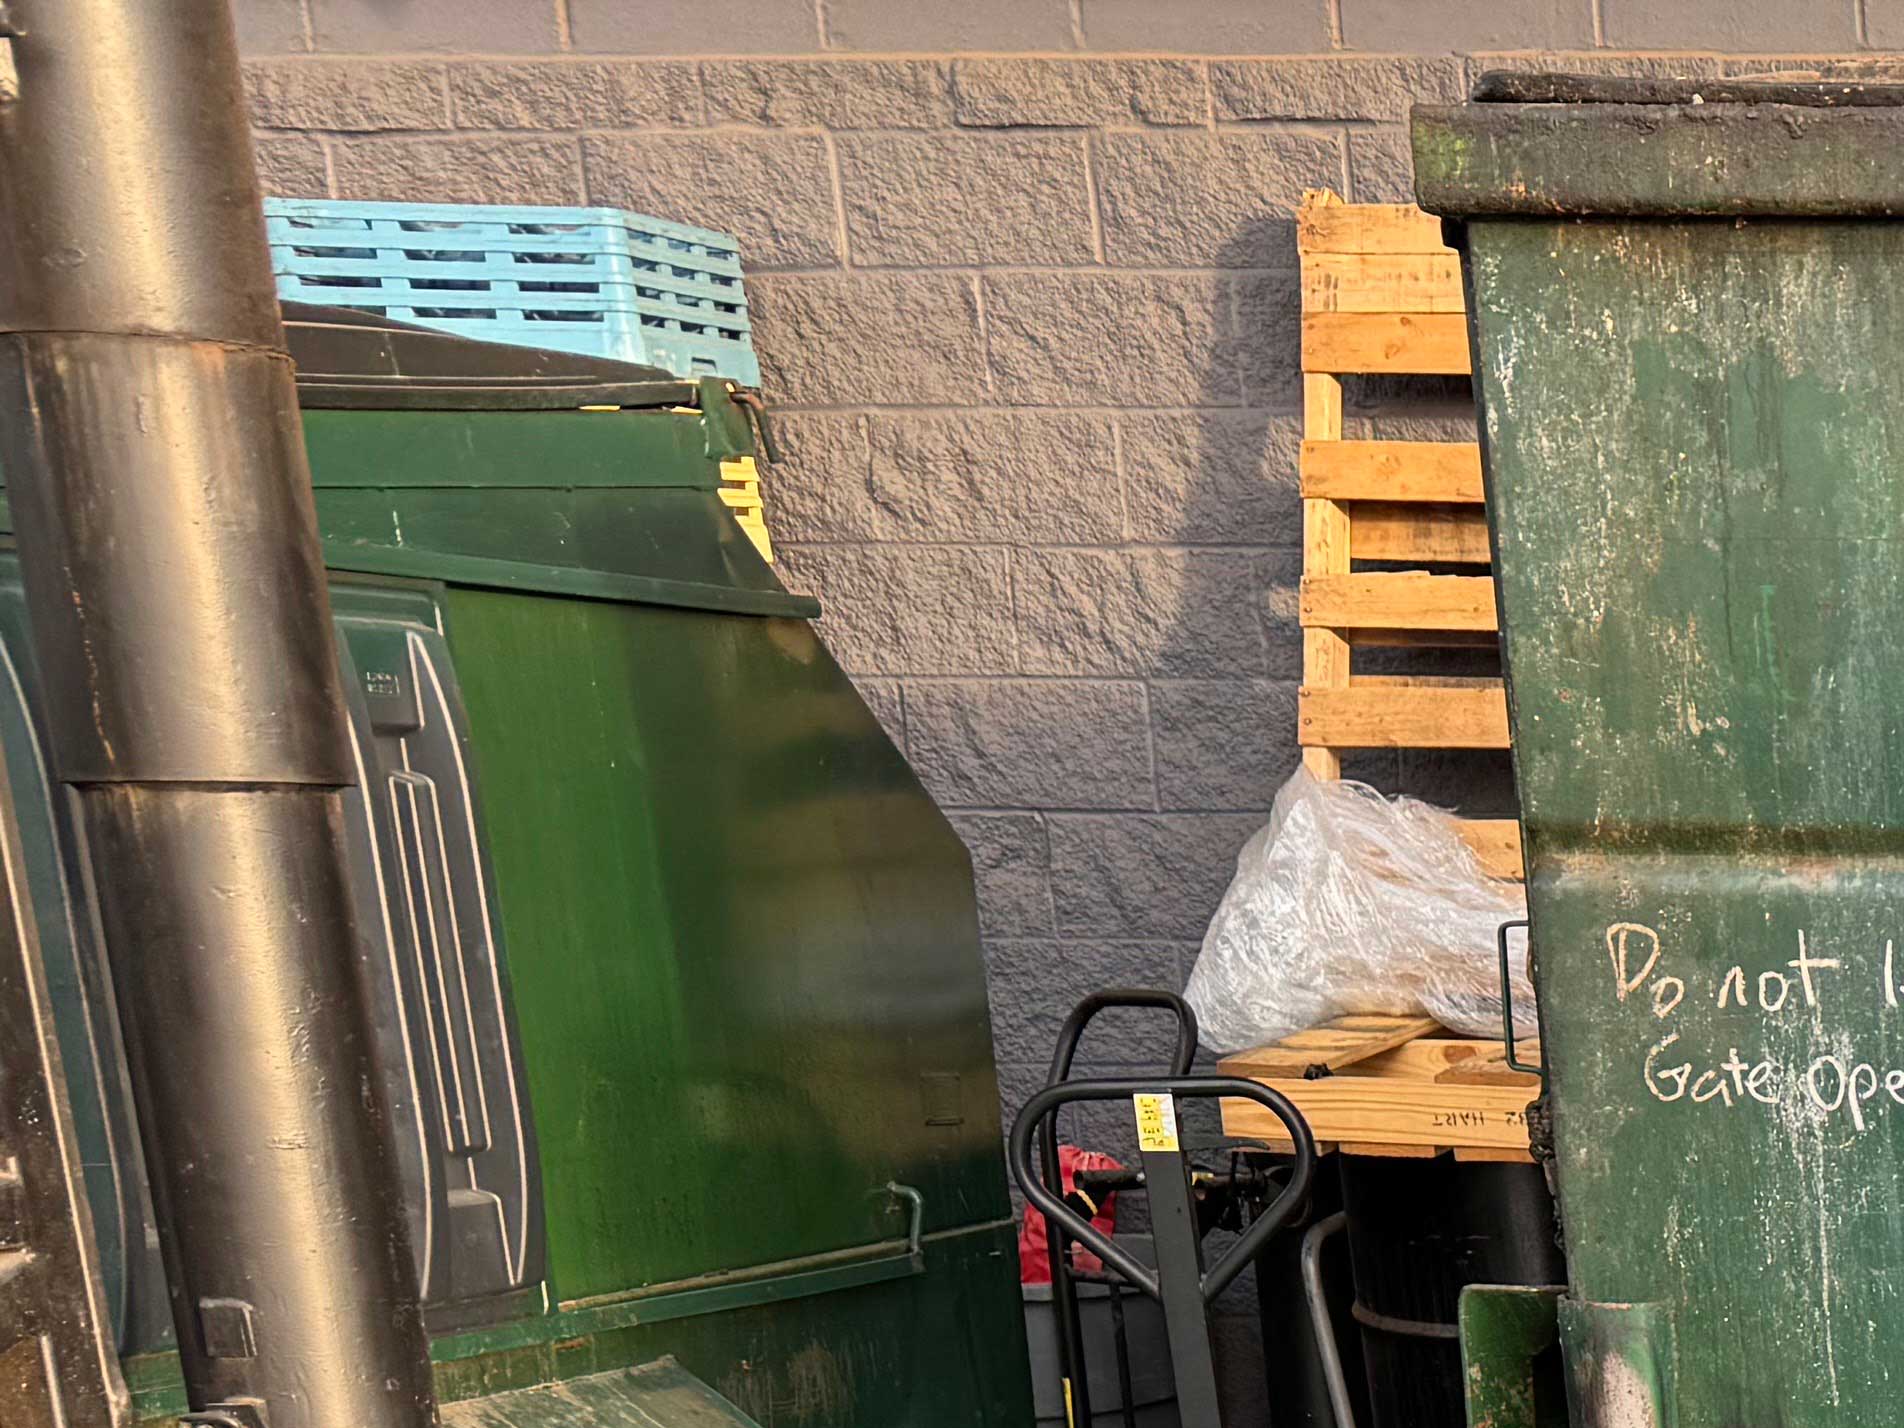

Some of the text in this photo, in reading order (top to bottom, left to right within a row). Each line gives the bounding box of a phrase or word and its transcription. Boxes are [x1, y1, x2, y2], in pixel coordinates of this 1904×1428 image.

[1606, 922, 1685, 1019] Do
[1717, 929, 1841, 1012] not
[1644, 1031, 1781, 1108] Gate
